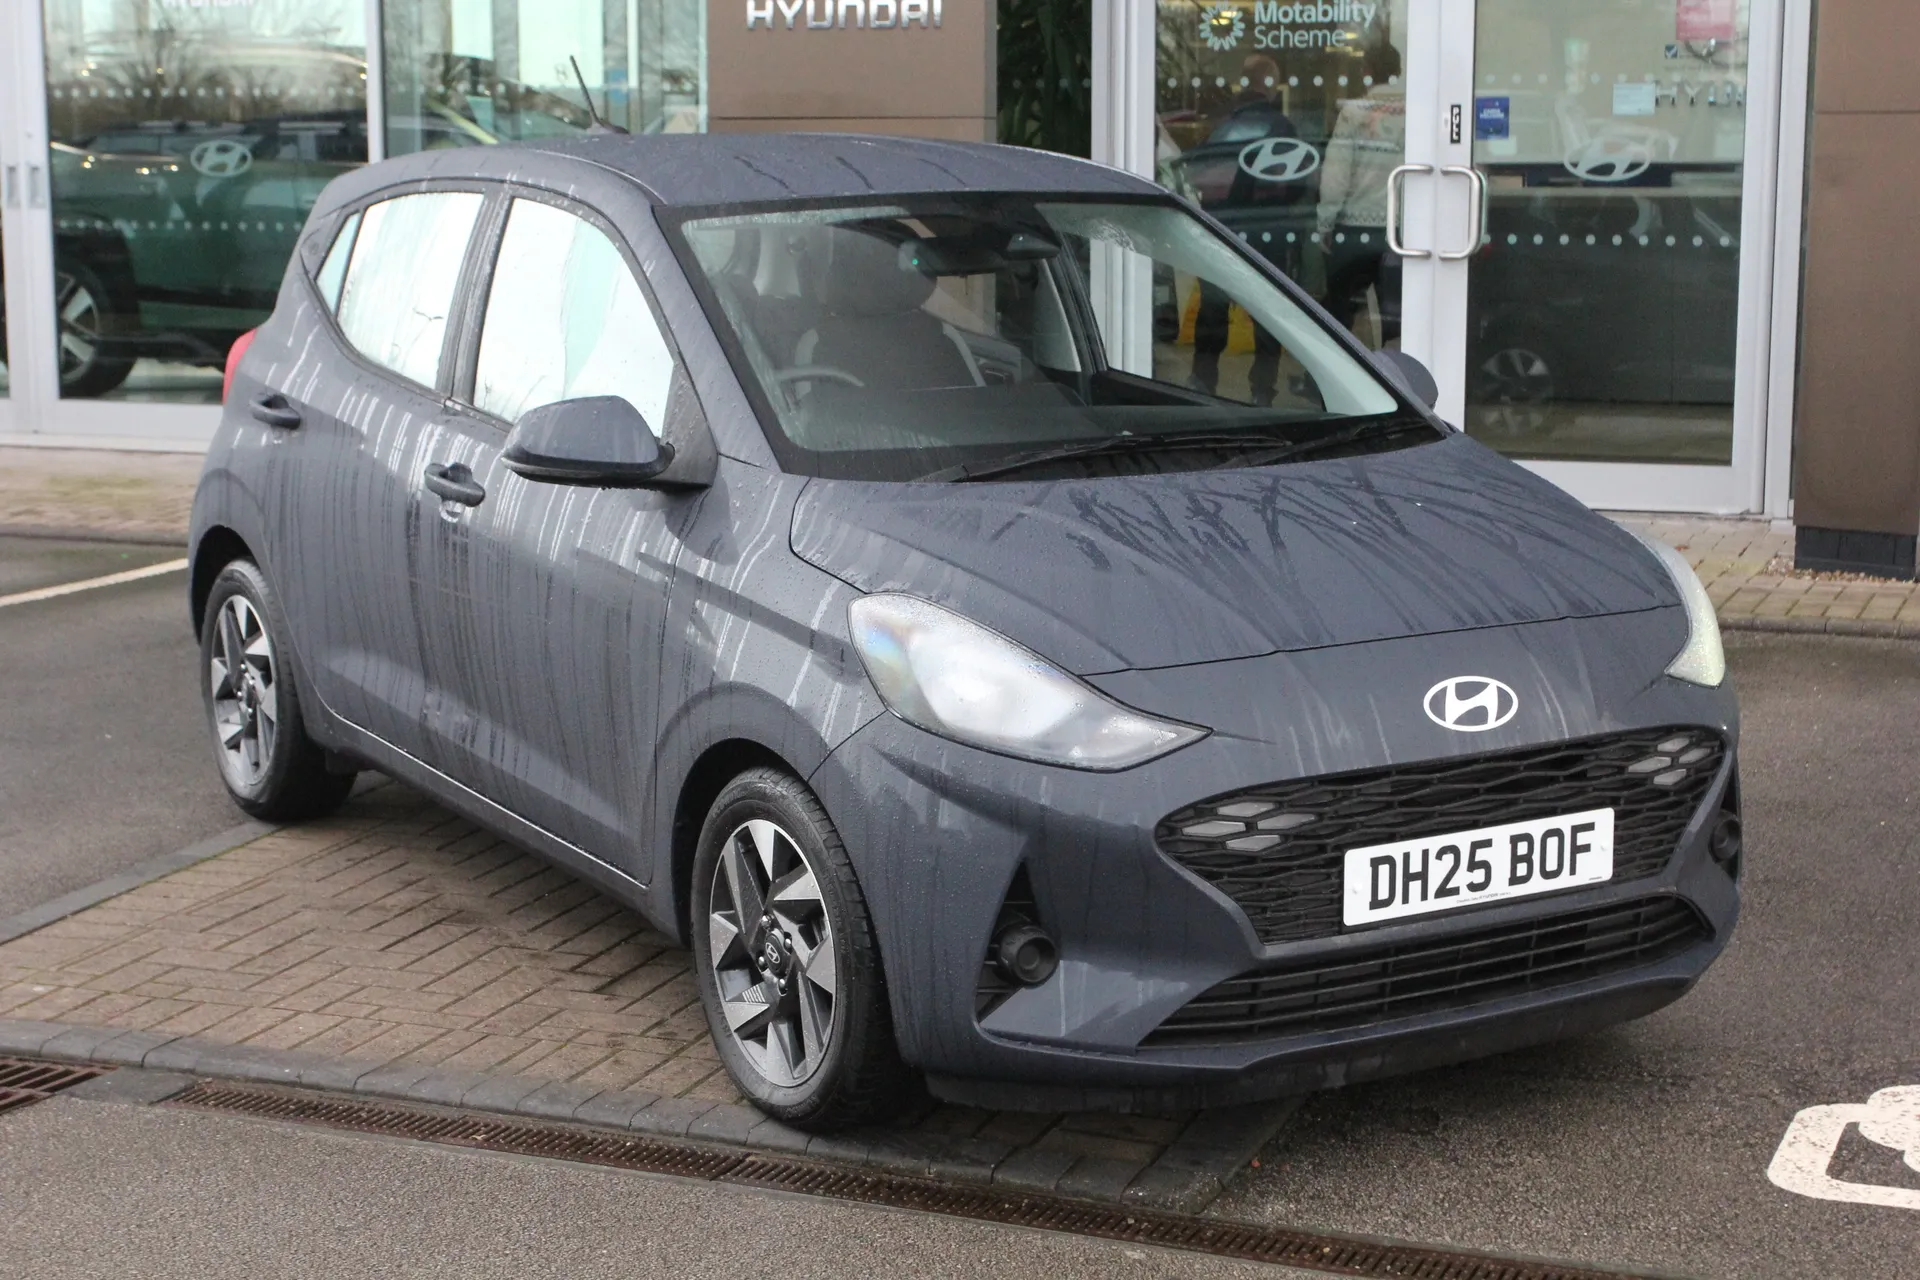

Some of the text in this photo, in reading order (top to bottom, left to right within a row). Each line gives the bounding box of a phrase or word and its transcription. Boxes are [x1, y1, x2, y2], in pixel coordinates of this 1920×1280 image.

[746, 0, 943, 30] HYUNDAI
[1254, 0, 1376, 32] Motability
[1254, 25, 1346, 49] Scheme
[1452, 106, 1460, 141] PULL
[1369, 822, 1596, 911] DH25 BOF
